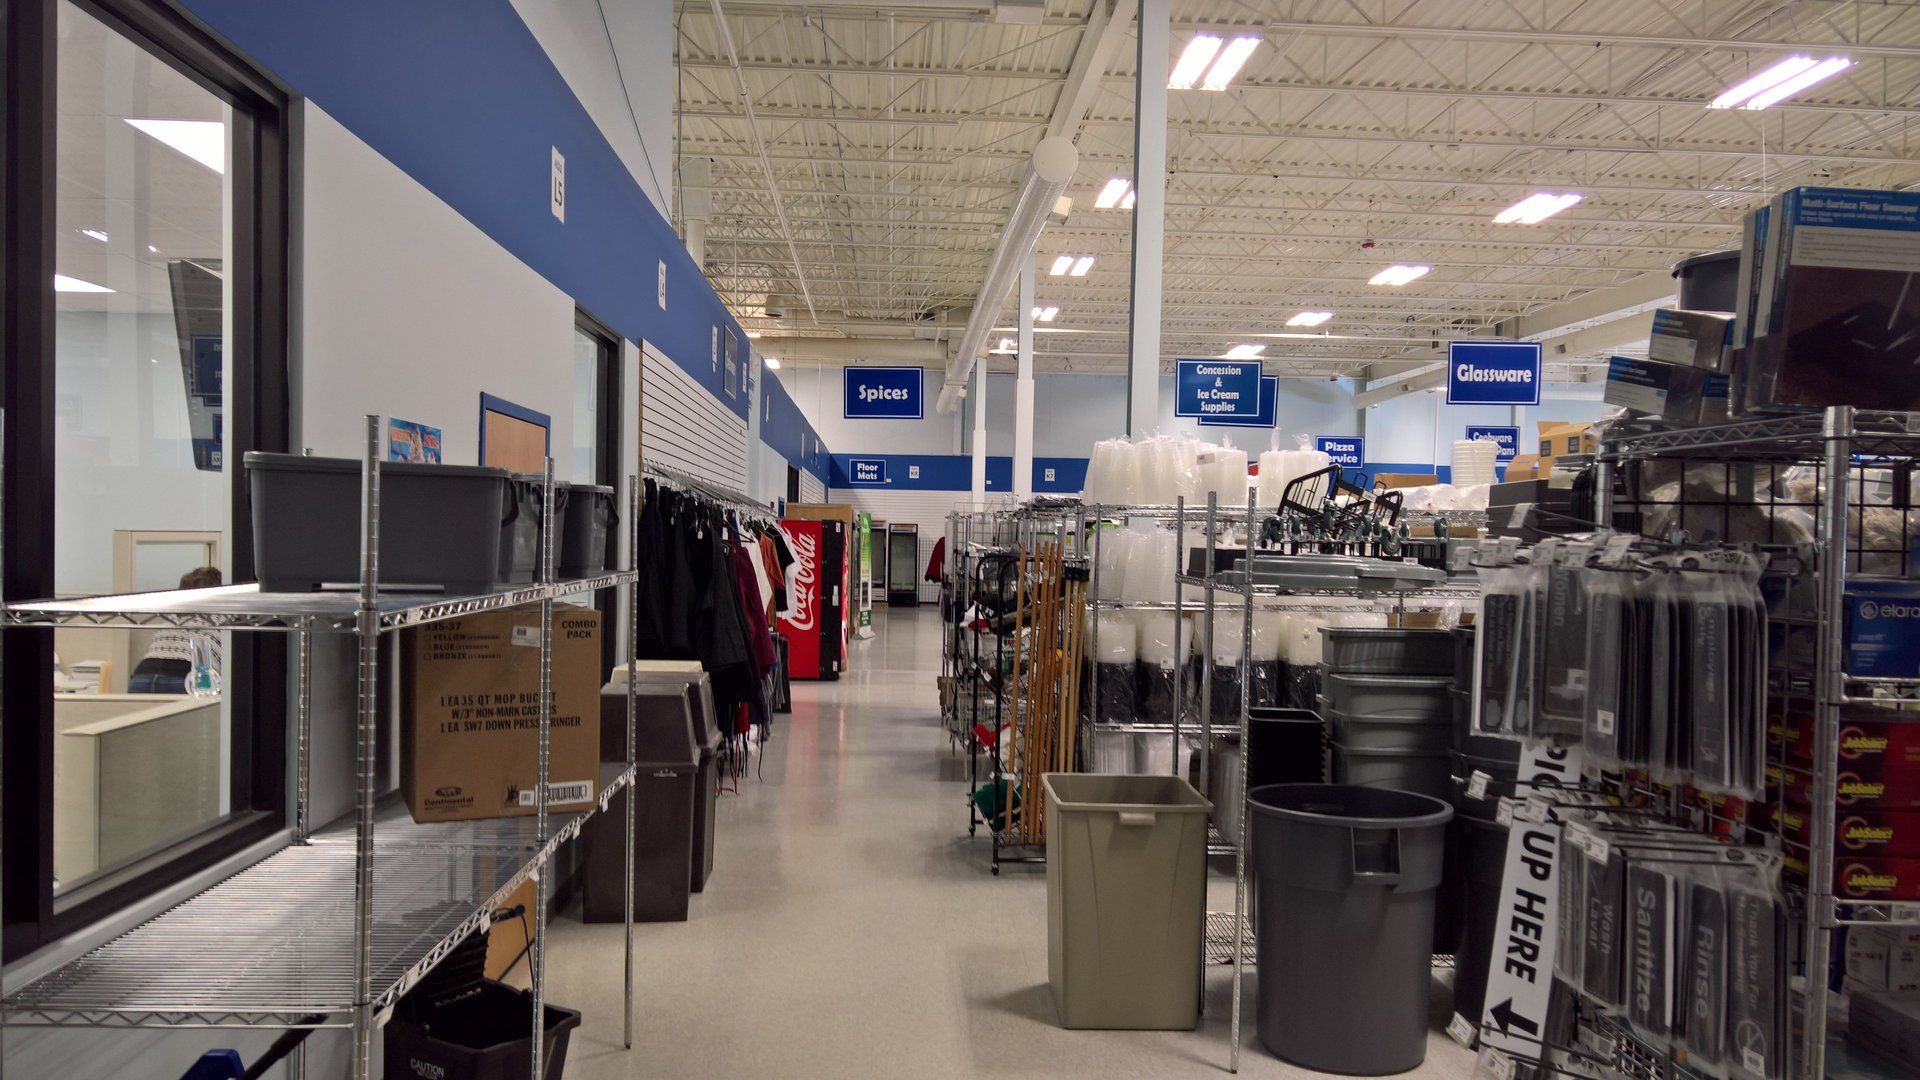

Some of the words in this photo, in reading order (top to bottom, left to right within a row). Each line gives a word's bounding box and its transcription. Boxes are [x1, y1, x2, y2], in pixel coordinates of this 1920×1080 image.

[554, 176, 563, 207] L5
[1196, 364, 1242, 375] Concession
[1456, 363, 1533, 382] Glassware
[1214, 377, 1223, 387] &
[858, 384, 908, 402] Spices
[1197, 389, 1210, 399] Ice
[1211, 389, 1240, 400] Cream
[1200, 401, 1235, 413] Supplies
[1324, 441, 1355, 452] Pizza
[1328, 453, 1358, 463] ervice
[857, 463, 878, 471] Floor
[857, 472, 878, 480] Mats
[1880, 604, 1920, 618] elara
[561, 619, 597, 630] COMBO
[433, 633, 467, 641] YELLOW
[566, 629, 592, 639] PACK
[433, 643, 455, 651] BLUE
[447, 696, 459, 707] EA
[461, 695, 474, 706] 35
[477, 695, 490, 706] QT
[494, 693, 515, 705] MOP
[519, 692, 556, 703] BUCT
[476, 706, 520, 718] NON-MARK
[447, 722, 459, 733] EA
[464, 720, 483, 732] SW7
[485, 719, 512, 730] DOWN
[513, 718, 541, 730] PRESS
[550, 716, 581, 728] RINGER
[424, 796, 474, 807] Continental
[1520, 830, 1555, 881] UP
[1601, 904, 1614, 954] Wash
[1750, 902, 1760, 946] Thank
[1505, 888, 1547, 985] HERE
[1636, 887, 1656, 1012] Sanitize
[1696, 925, 1714, 1019] Rinse
[1749, 954, 1760, 980] You
[1750, 986, 1760, 1009] For
[410, 1058, 445, 1078] CAUTION
